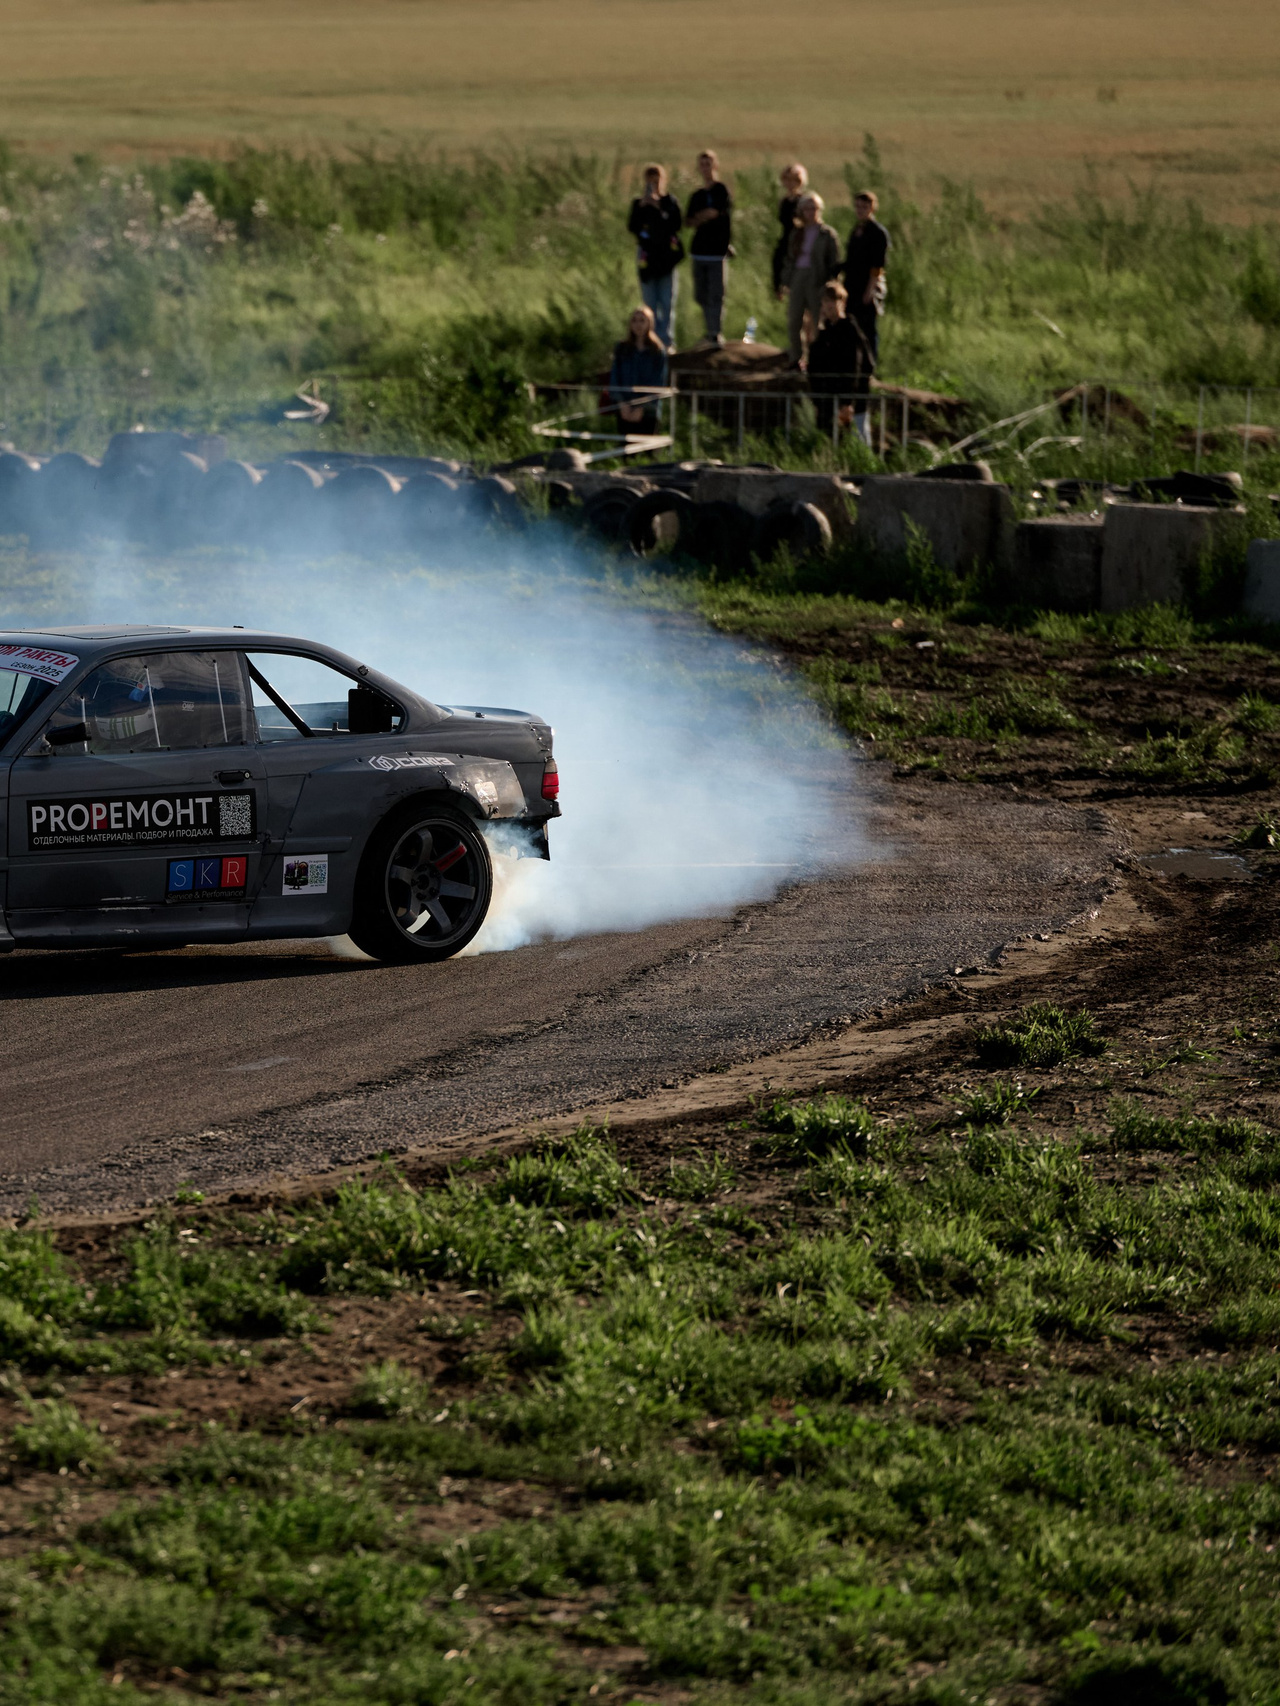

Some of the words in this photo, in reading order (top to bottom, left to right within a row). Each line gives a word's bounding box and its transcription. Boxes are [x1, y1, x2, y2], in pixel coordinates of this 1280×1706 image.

[15, 648, 77, 667] РАКЕТЫ
[10, 661, 37, 671] СЕЗОН
[34, 665, 63, 677] 2025
[33, 834, 85, 845] ОТДЕЛОЧНЫЕ
[136, 830, 168, 840] ПОДБОР
[168, 830, 175, 838] И
[176, 828, 214, 837] ПРОДАЖА
[174, 861, 240, 887] SKR
[167, 892, 193, 900] Service
[194, 891, 200, 899] &
